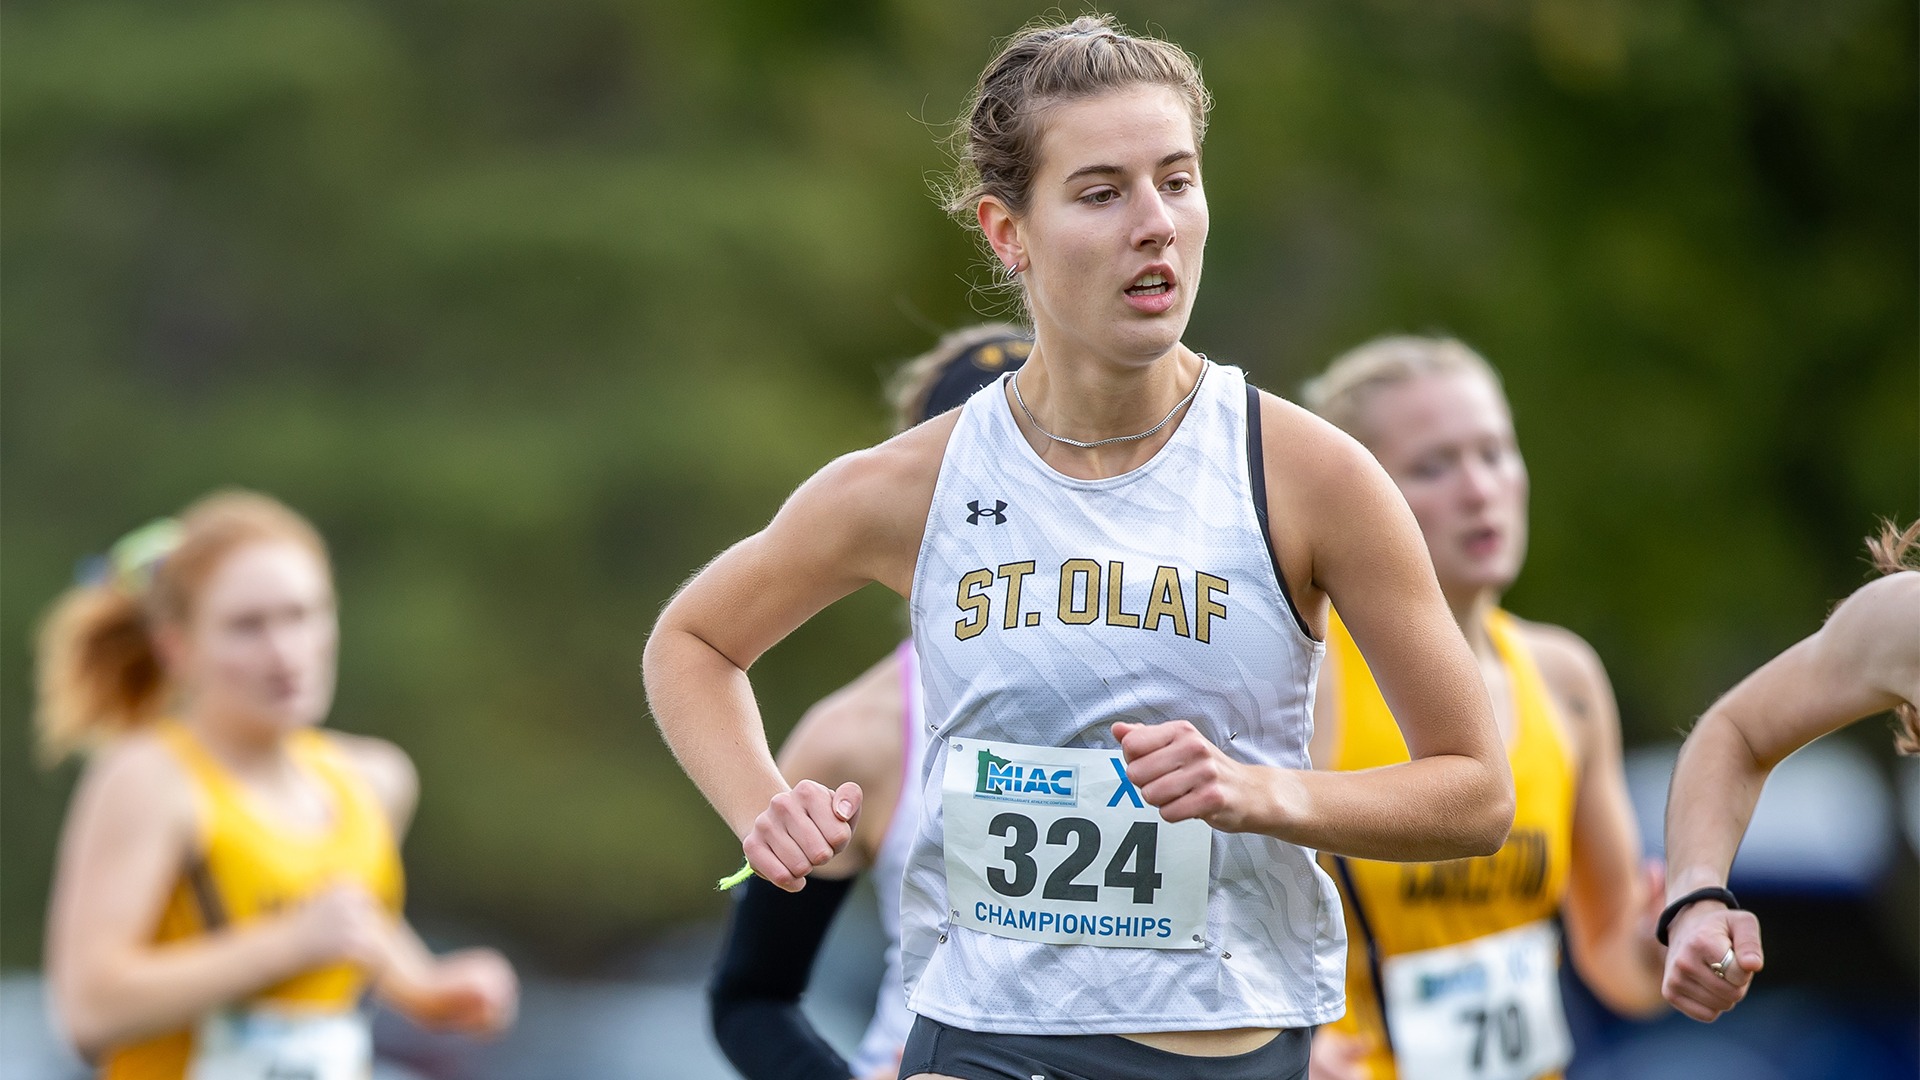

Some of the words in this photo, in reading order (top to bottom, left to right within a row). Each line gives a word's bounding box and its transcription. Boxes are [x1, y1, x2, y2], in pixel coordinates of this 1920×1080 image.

[955, 560, 1041, 641] ST.
[1057, 558, 1229, 644] OLAF
[987, 763, 1072, 796] MIAC
[986, 812, 1162, 905] 324
[975, 901, 1172, 938] CHAMPIONSHIPS
[1459, 998, 1530, 1072] 70
